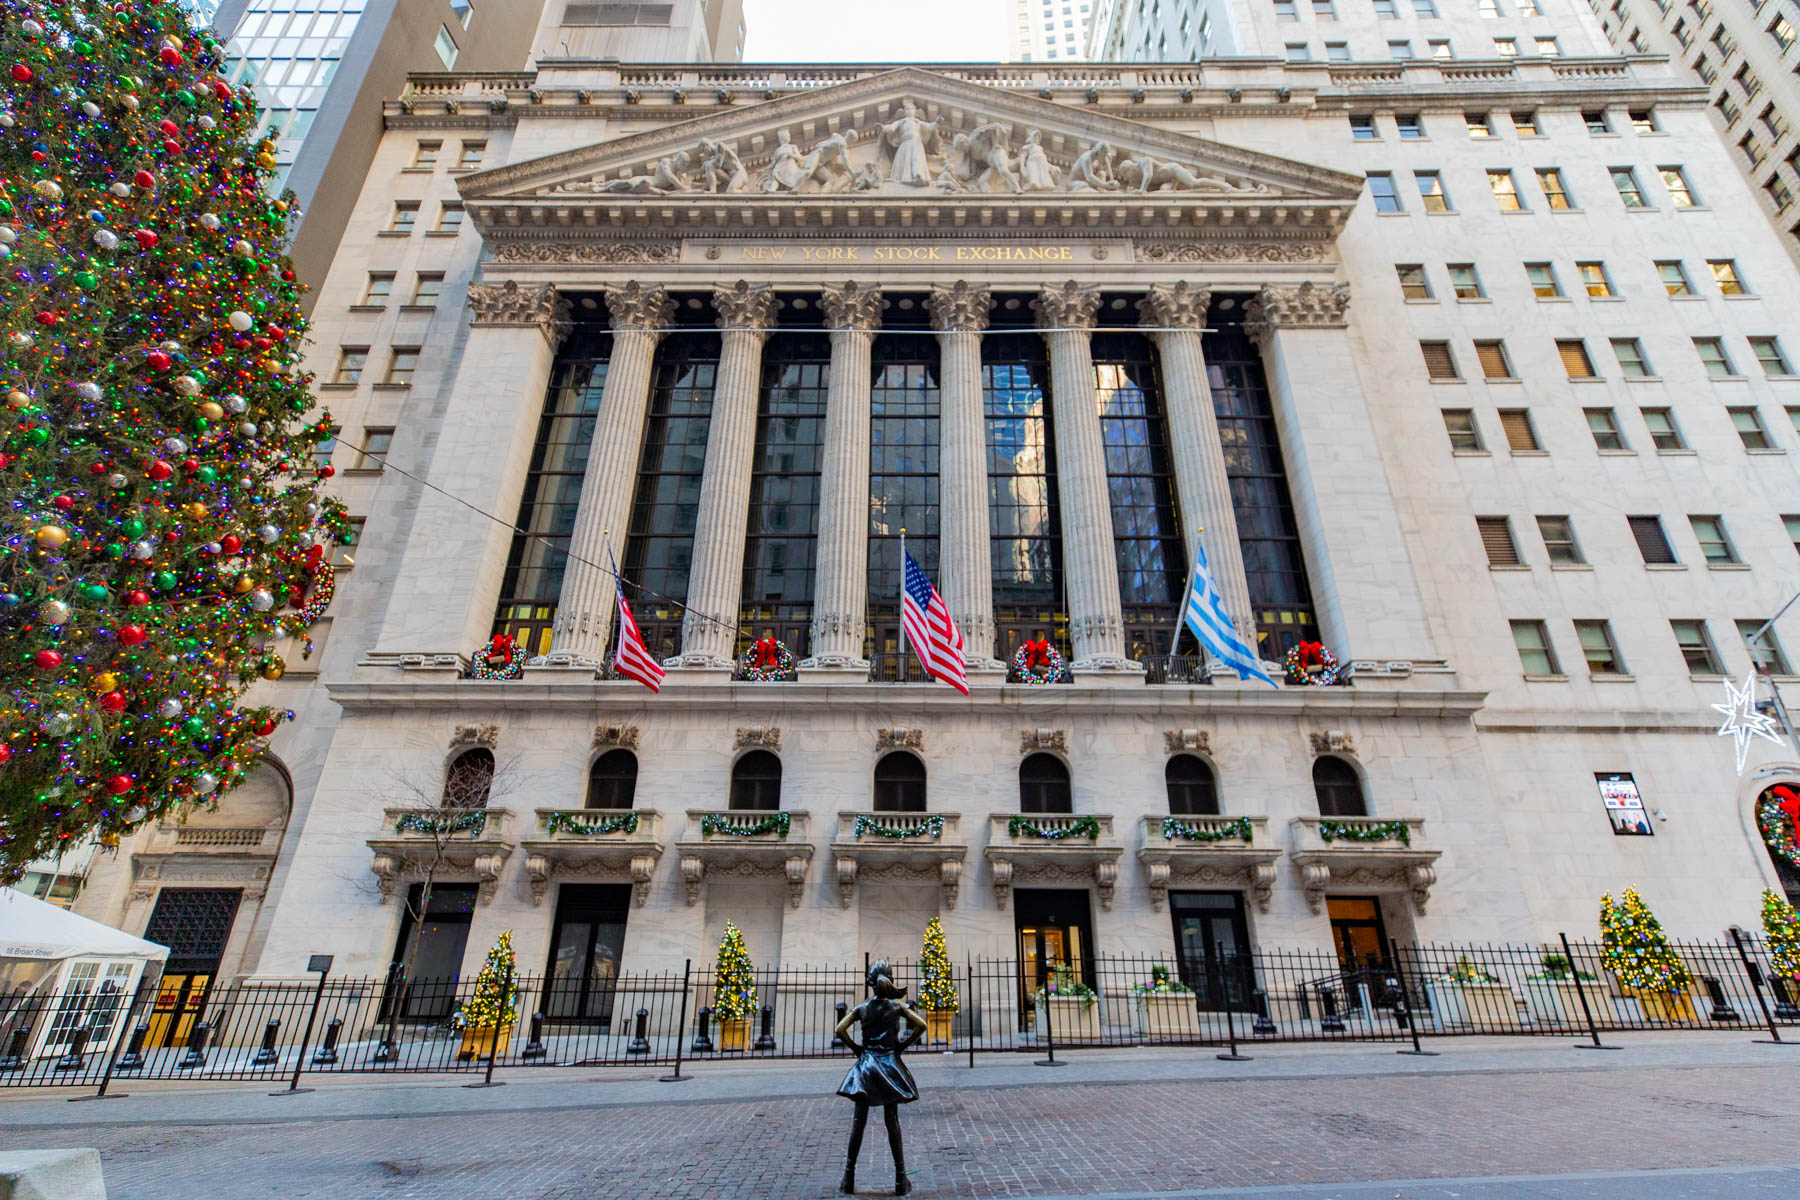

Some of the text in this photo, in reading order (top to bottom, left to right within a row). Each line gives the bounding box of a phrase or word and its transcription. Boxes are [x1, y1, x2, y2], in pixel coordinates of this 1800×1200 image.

[739, 247, 1073, 260] NEW YORK STOCK EXCHANGE
[6, 947, 54, 957] 18 Broad Street
